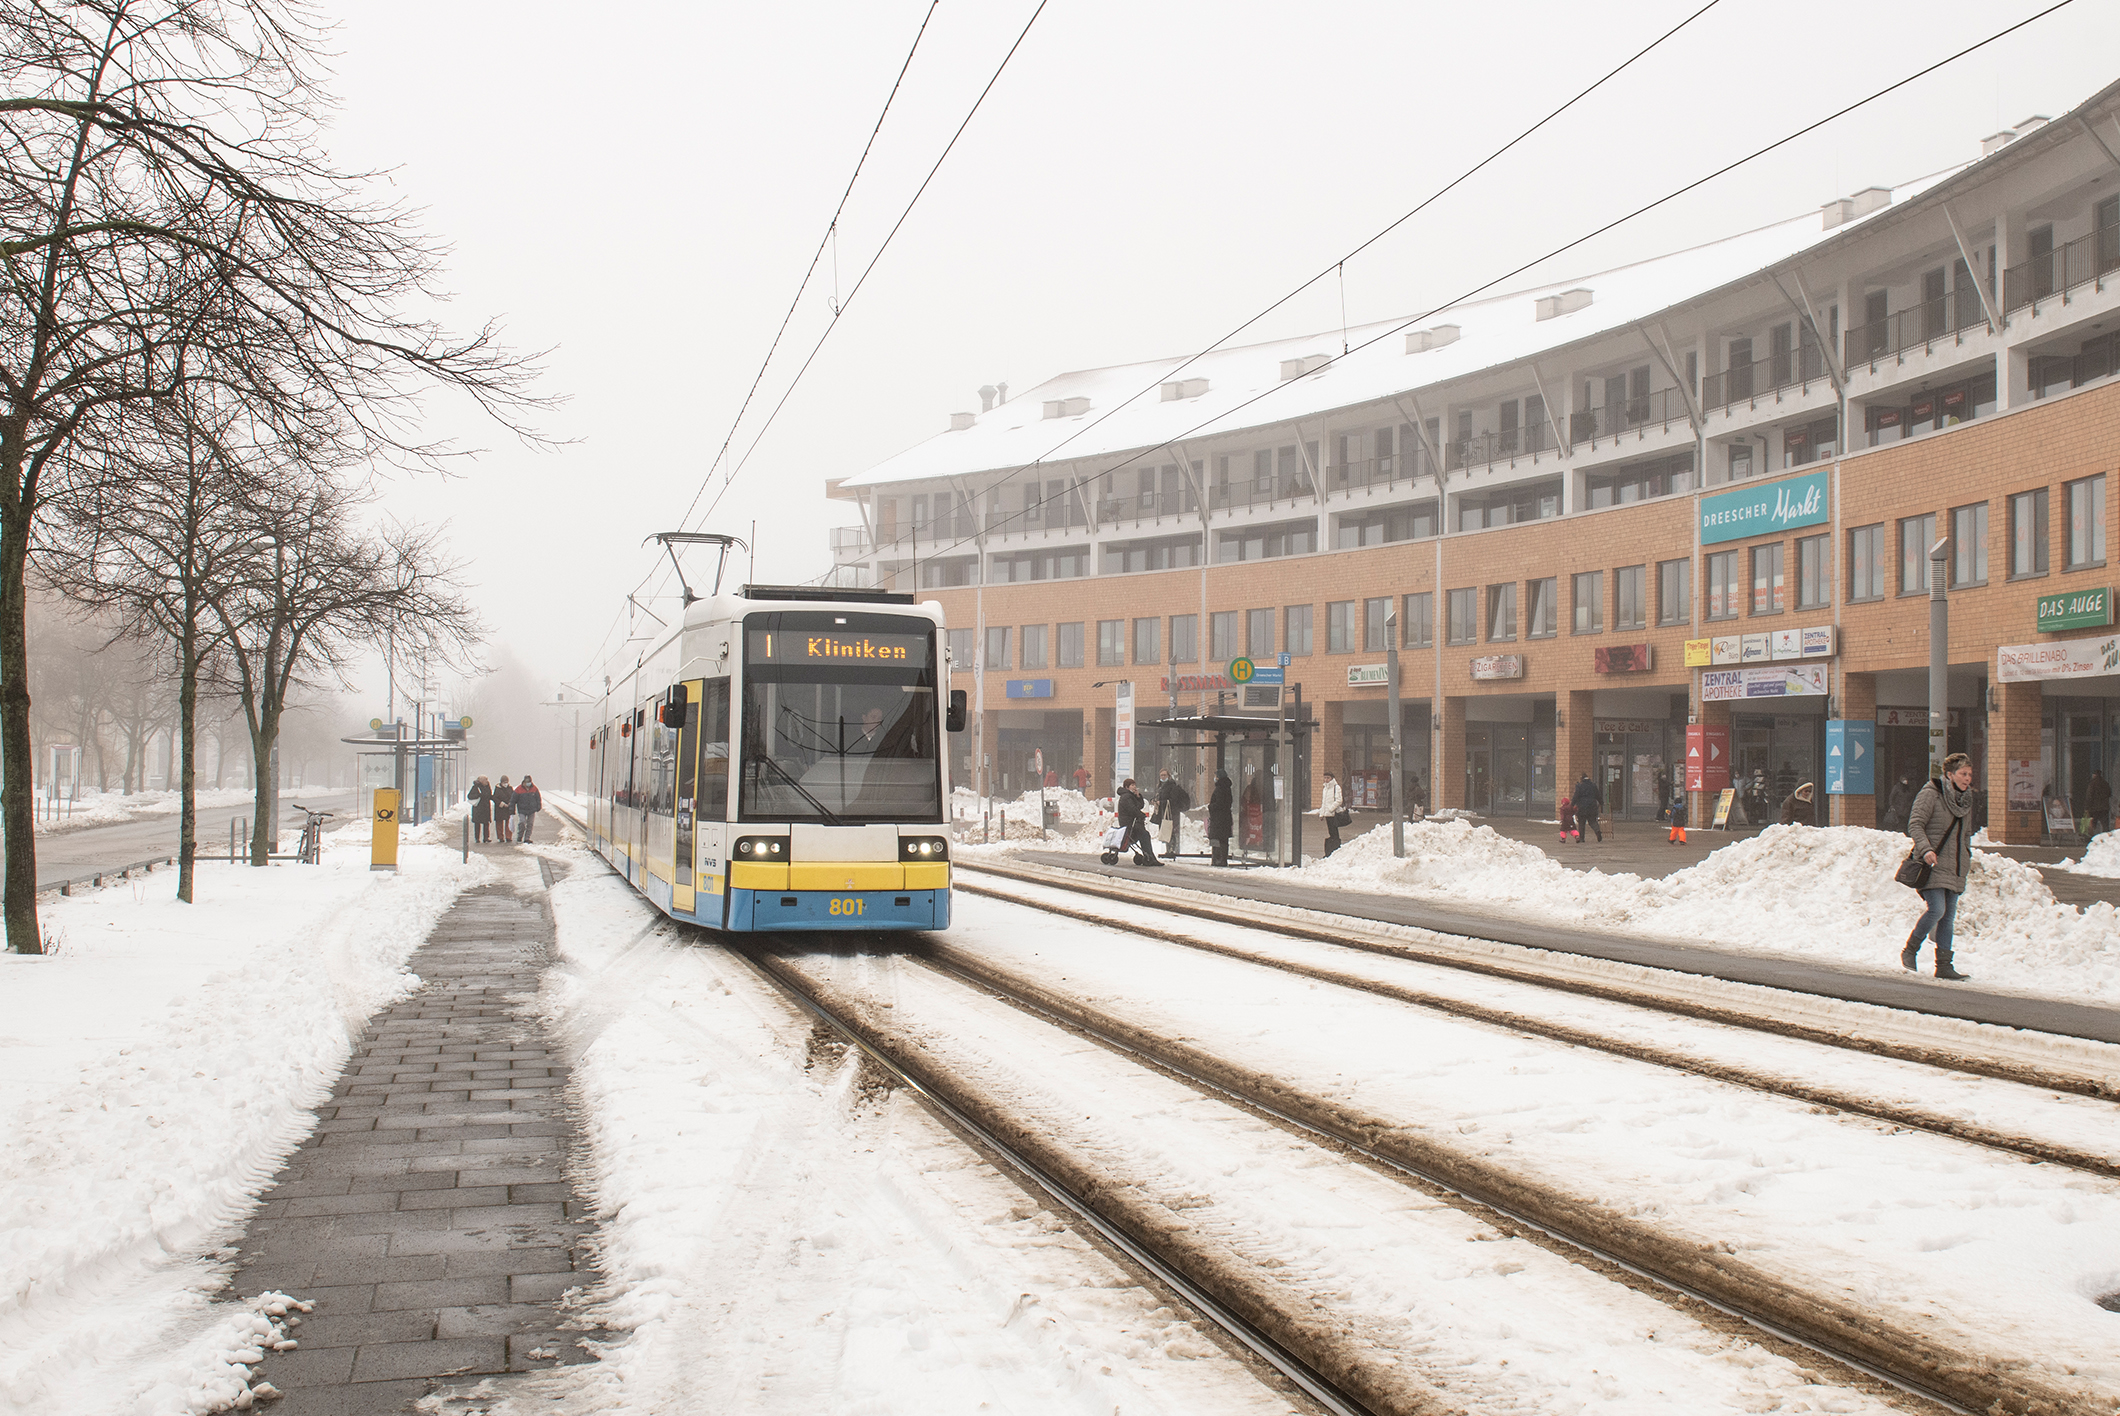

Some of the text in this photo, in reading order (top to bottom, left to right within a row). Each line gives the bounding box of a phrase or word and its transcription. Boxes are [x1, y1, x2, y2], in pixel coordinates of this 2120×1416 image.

[1703, 484, 1822, 527] DREESCHER Markt
[2040, 594, 2103, 618] DAS AUGE
[1804, 631, 1827, 640] ZENTRAL
[1804, 637, 1827, 646] APOTHEKE
[808, 638, 906, 659] Kliniken
[2100, 639, 2116, 656] DAS
[2001, 649, 2068, 666] DAS BRILLENABO
[2103, 649, 2120, 671] AU
[1237, 663, 1247, 678] H
[2072, 662, 2093, 672] Zinsen
[1161, 675, 1237, 692] RSSMAN
[1704, 671, 1742, 687] ZENTRAL
[1704, 684, 1742, 700] APOTHEKE
[1599, 722, 1615, 731] Tee
[1618, 722, 1625, 731] &
[703, 876, 714, 892] 801
[829, 898, 863, 916] 801
